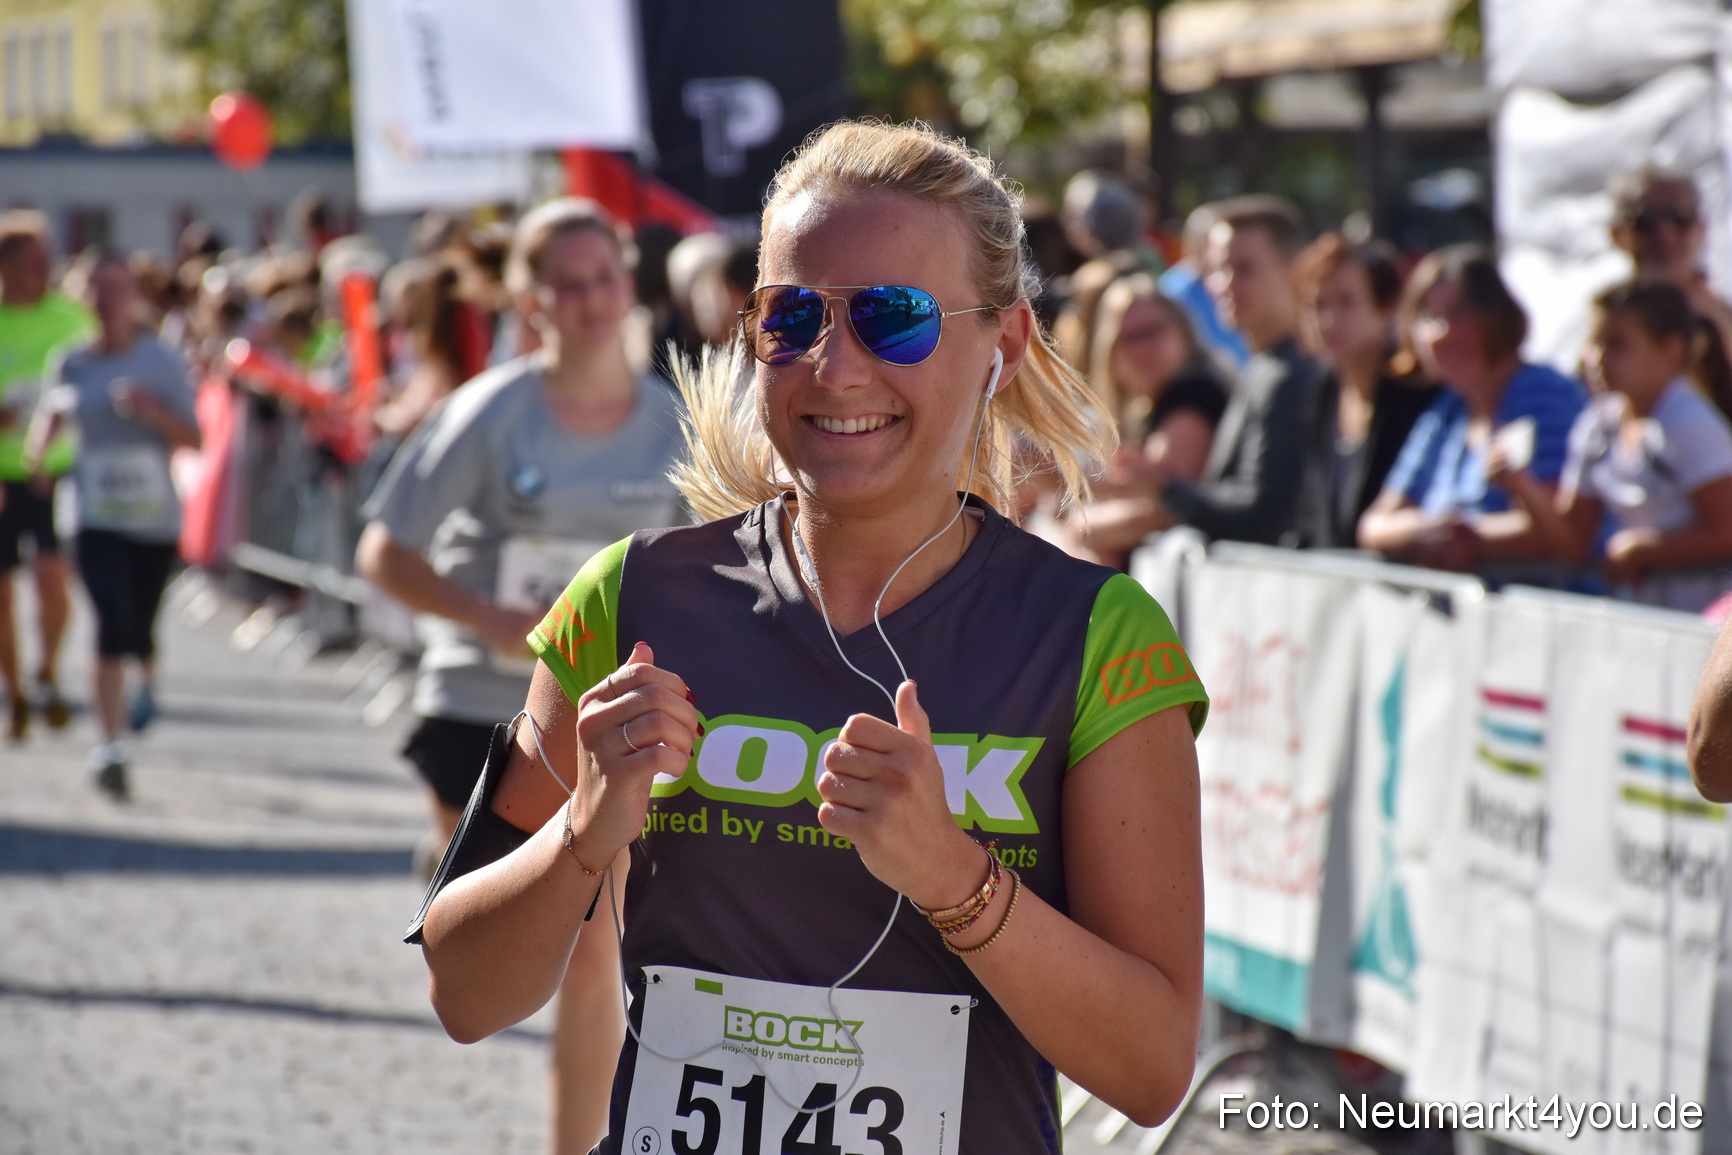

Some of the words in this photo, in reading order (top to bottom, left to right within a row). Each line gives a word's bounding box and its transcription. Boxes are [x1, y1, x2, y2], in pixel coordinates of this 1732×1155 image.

[1099, 642, 1201, 707] BO
[647, 706, 1046, 835] OK
[721, 808, 764, 843] by
[776, 822, 853, 850] sma
[722, 1039, 758, 1056] inspired
[761, 1047, 775, 1060] by
[777, 1050, 810, 1063] smart
[813, 1054, 864, 1069] concepts
[724, 1005, 864, 1055] BOCK
[671, 1063, 905, 1155] 5143
[640, 1134, 652, 1154] S
